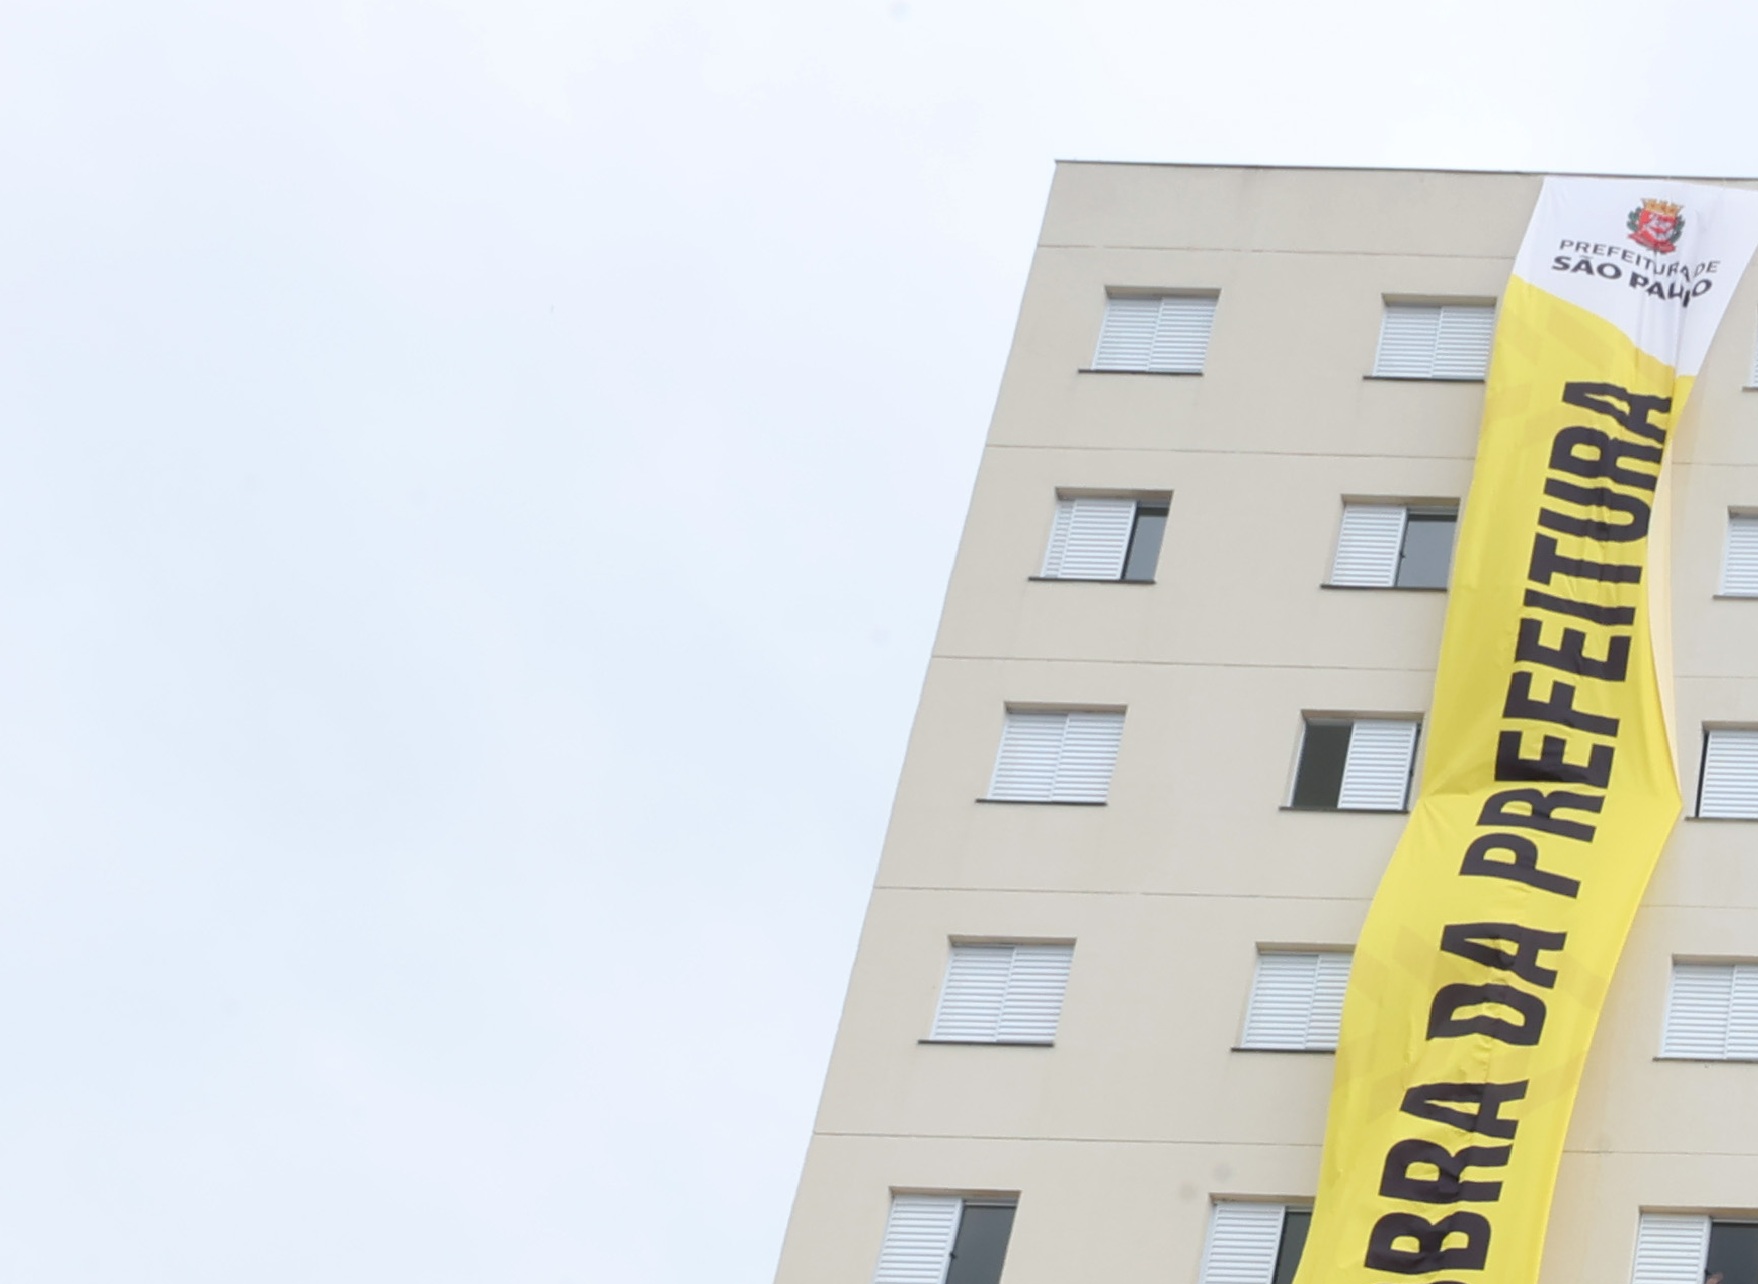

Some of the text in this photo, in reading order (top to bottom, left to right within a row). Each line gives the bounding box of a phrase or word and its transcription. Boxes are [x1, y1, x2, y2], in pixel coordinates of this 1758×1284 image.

[1551, 253, 1713, 308] SÃO PAULO
[1559, 239, 1721, 282] PREFEITURA DE
[1460, 380, 1673, 898] PREFEITURA
[1426, 923, 1567, 1046] DA
